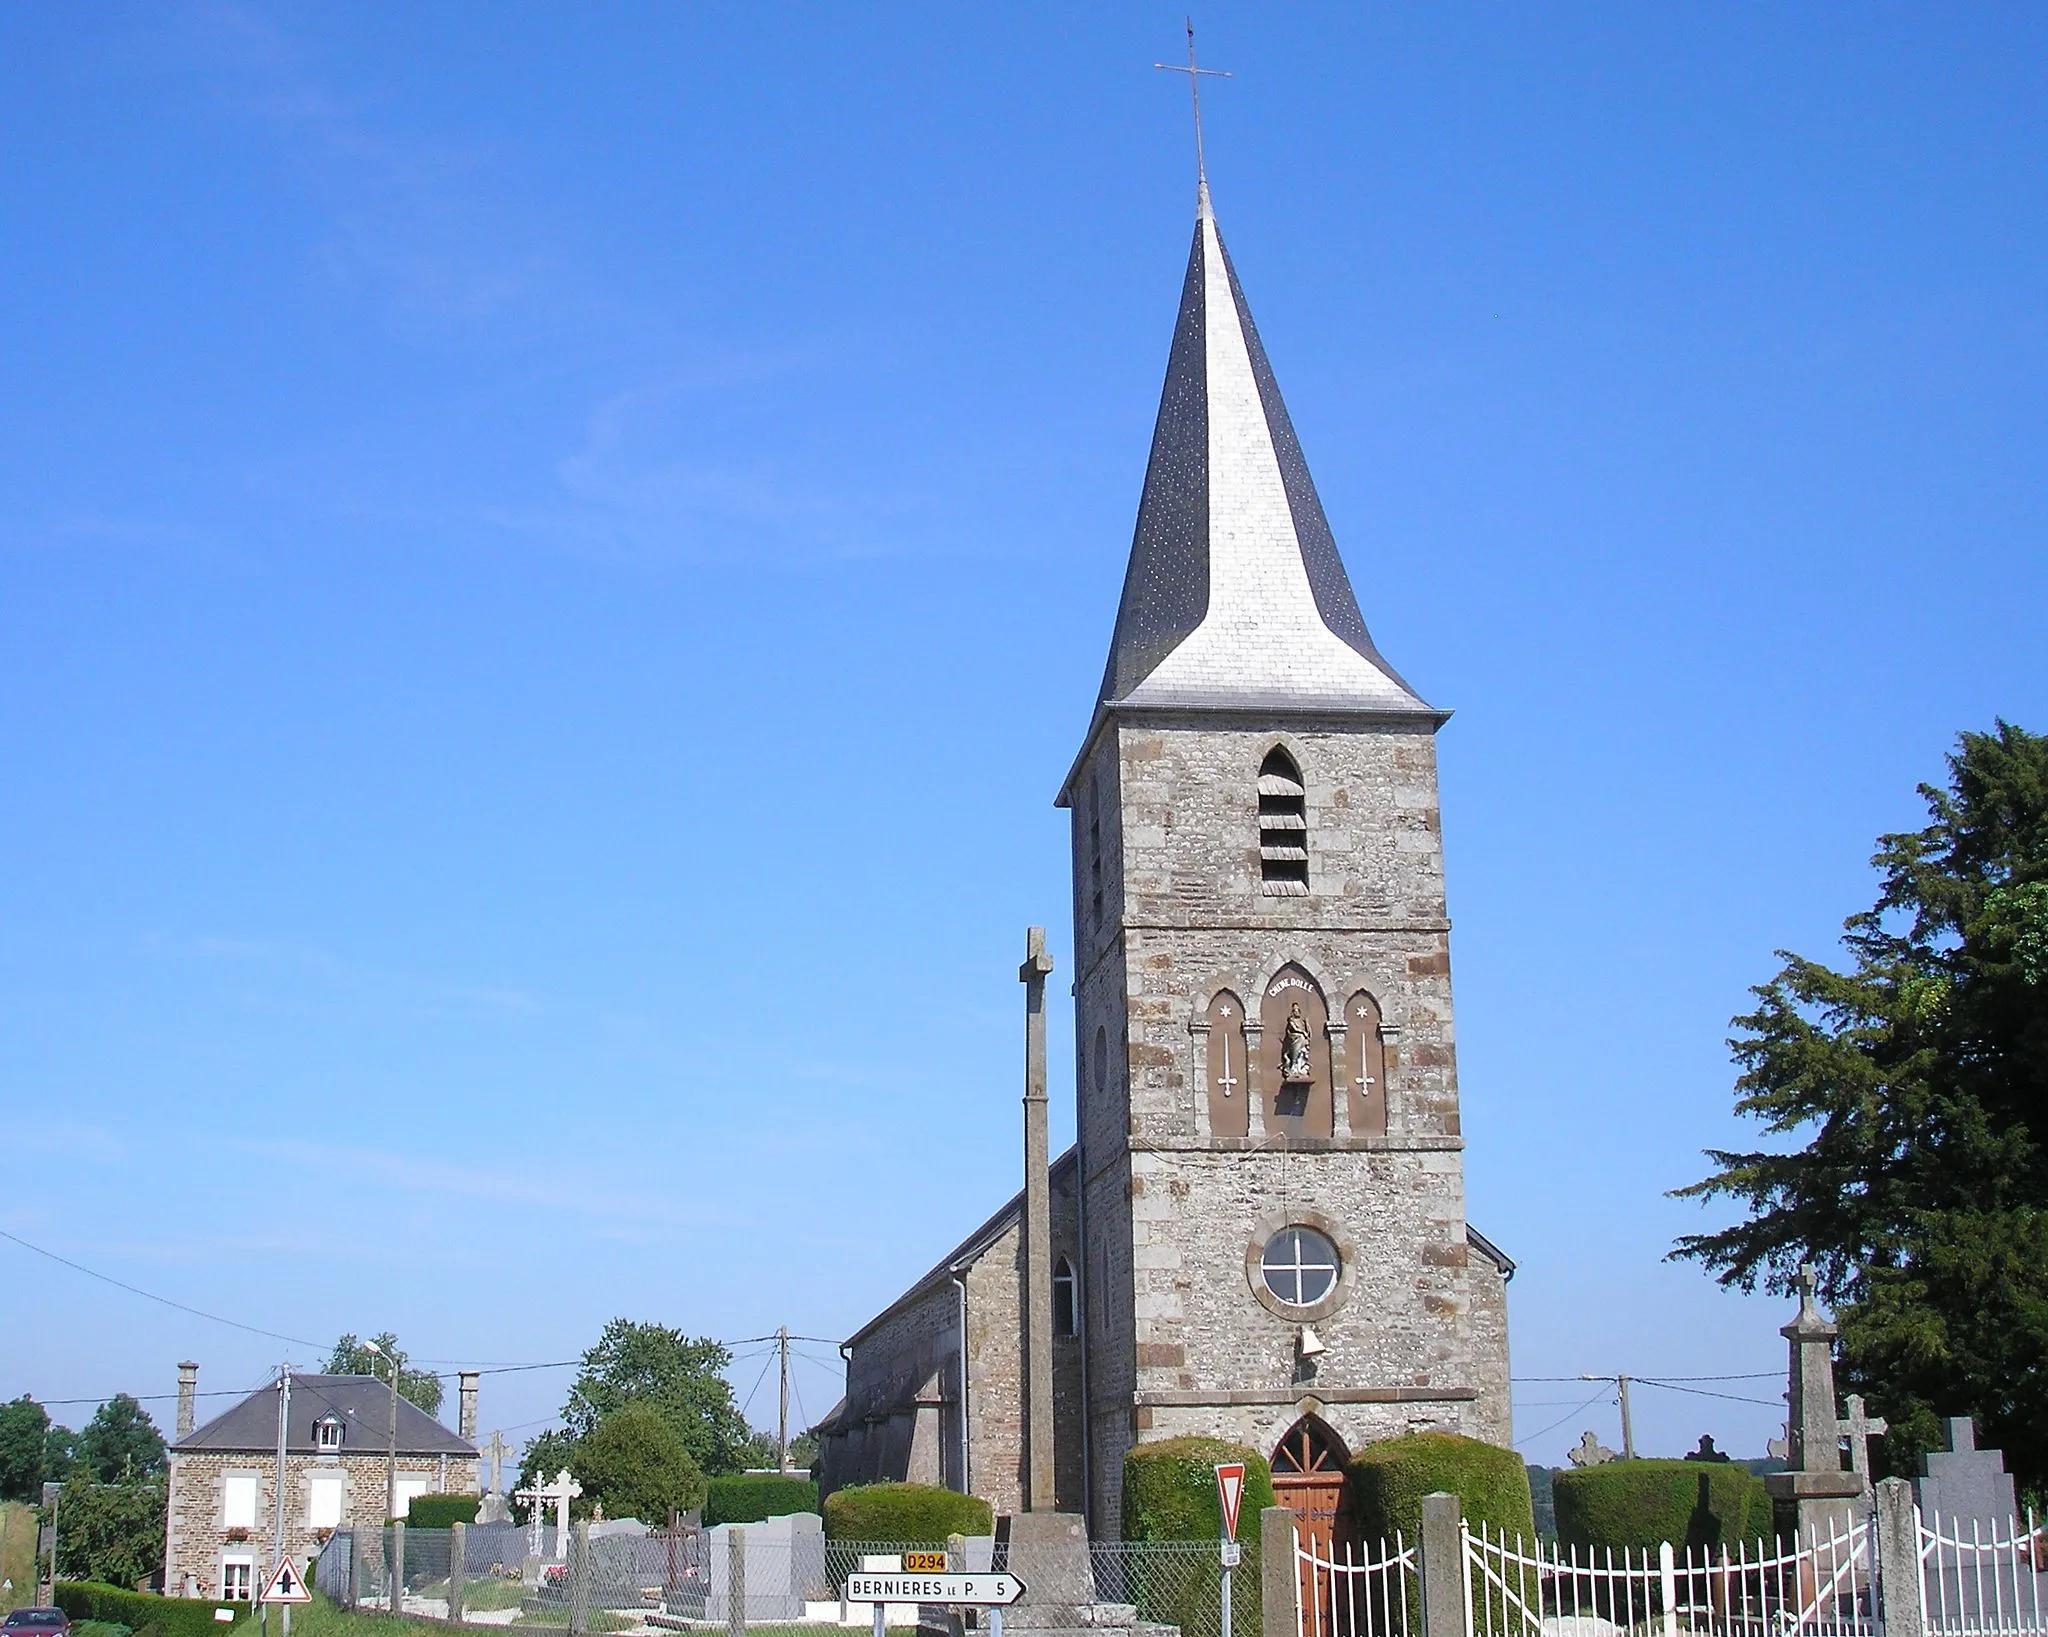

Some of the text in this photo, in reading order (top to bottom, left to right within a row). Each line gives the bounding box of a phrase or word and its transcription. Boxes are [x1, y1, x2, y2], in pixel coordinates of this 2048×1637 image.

[908, 1555, 945, 1570] D294
[853, 1580, 1005, 1596] BERNIERES LE P. 5
